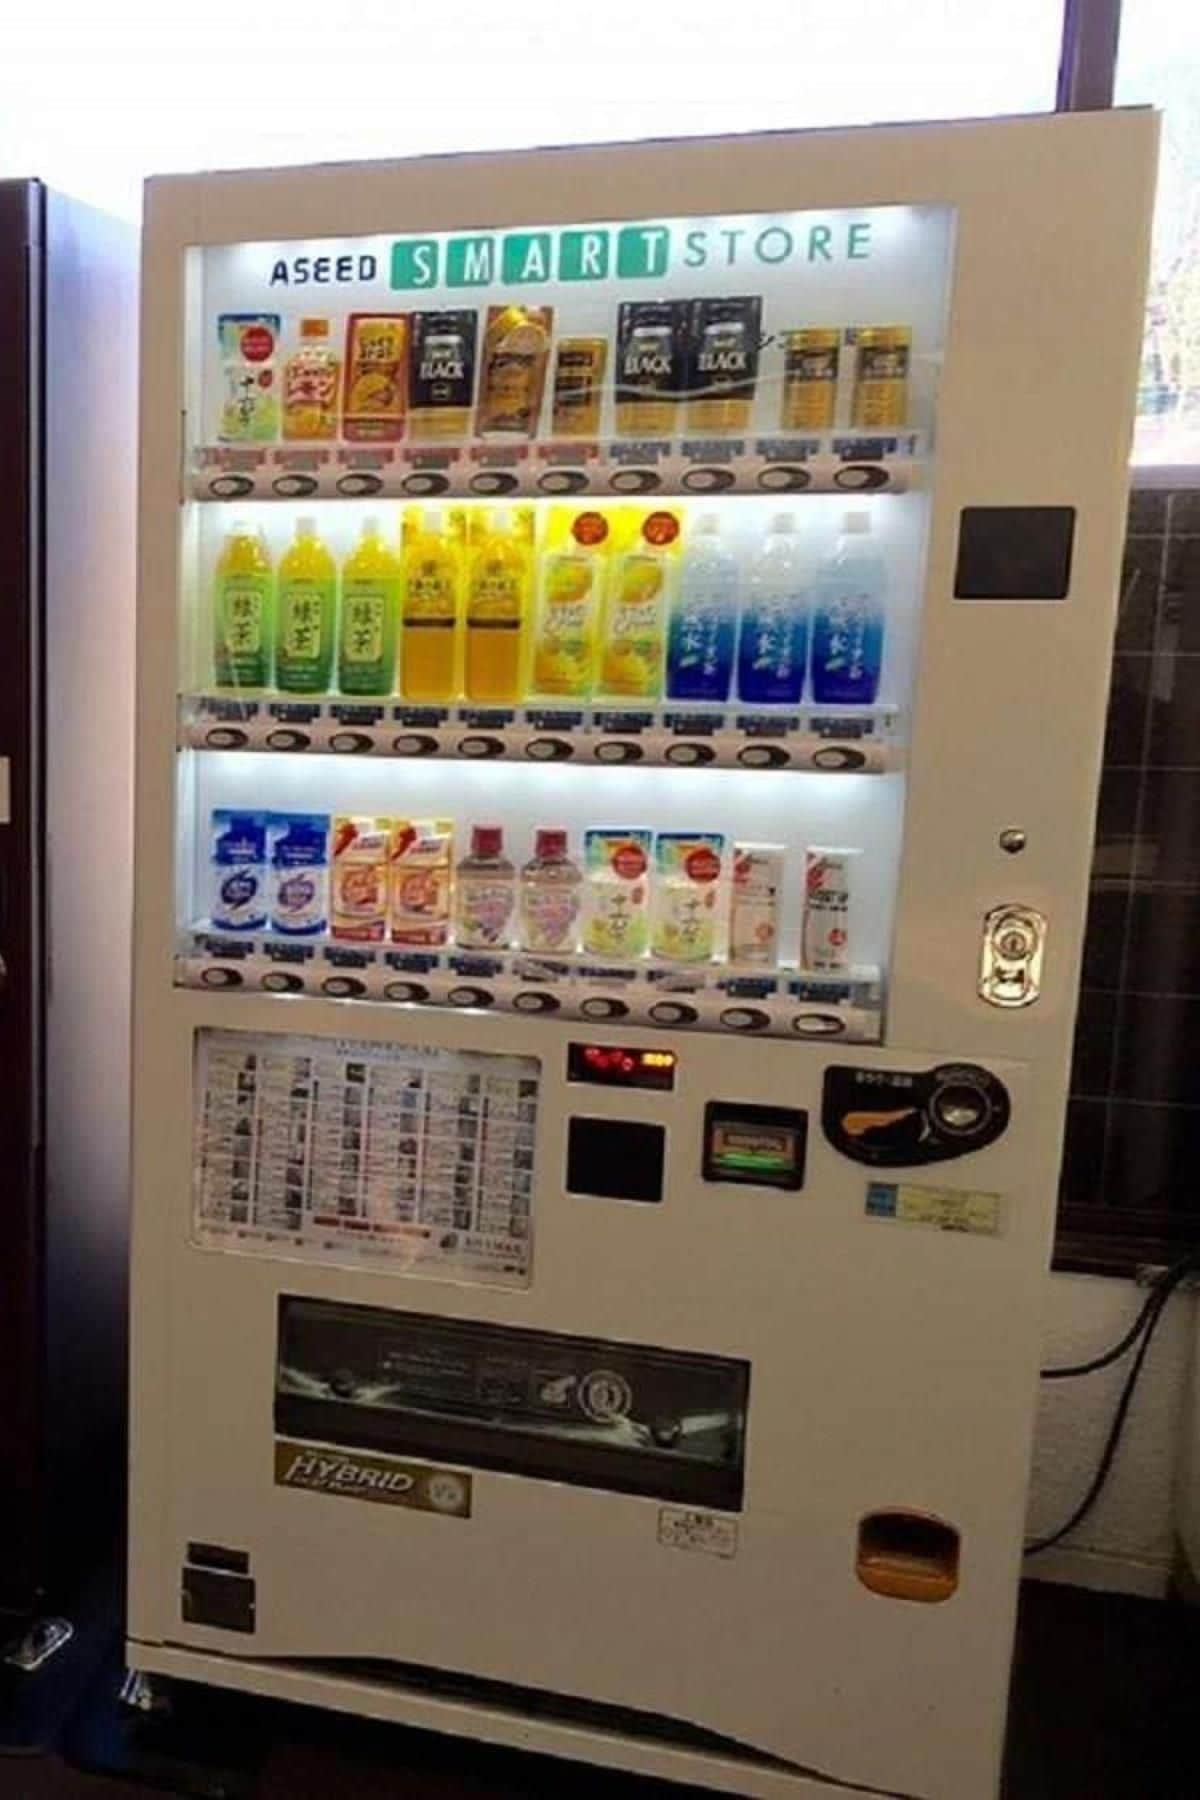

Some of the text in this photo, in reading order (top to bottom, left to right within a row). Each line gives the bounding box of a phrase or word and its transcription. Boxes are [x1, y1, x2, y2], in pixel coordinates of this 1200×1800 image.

[269, 222, 871, 287] ASEED SMART STORE
[419, 360, 465, 380] BLACK
[624, 353, 672, 375] BLACK
[697, 350, 747, 374] BLACK
[284, 1454, 416, 1492] HYBRID
